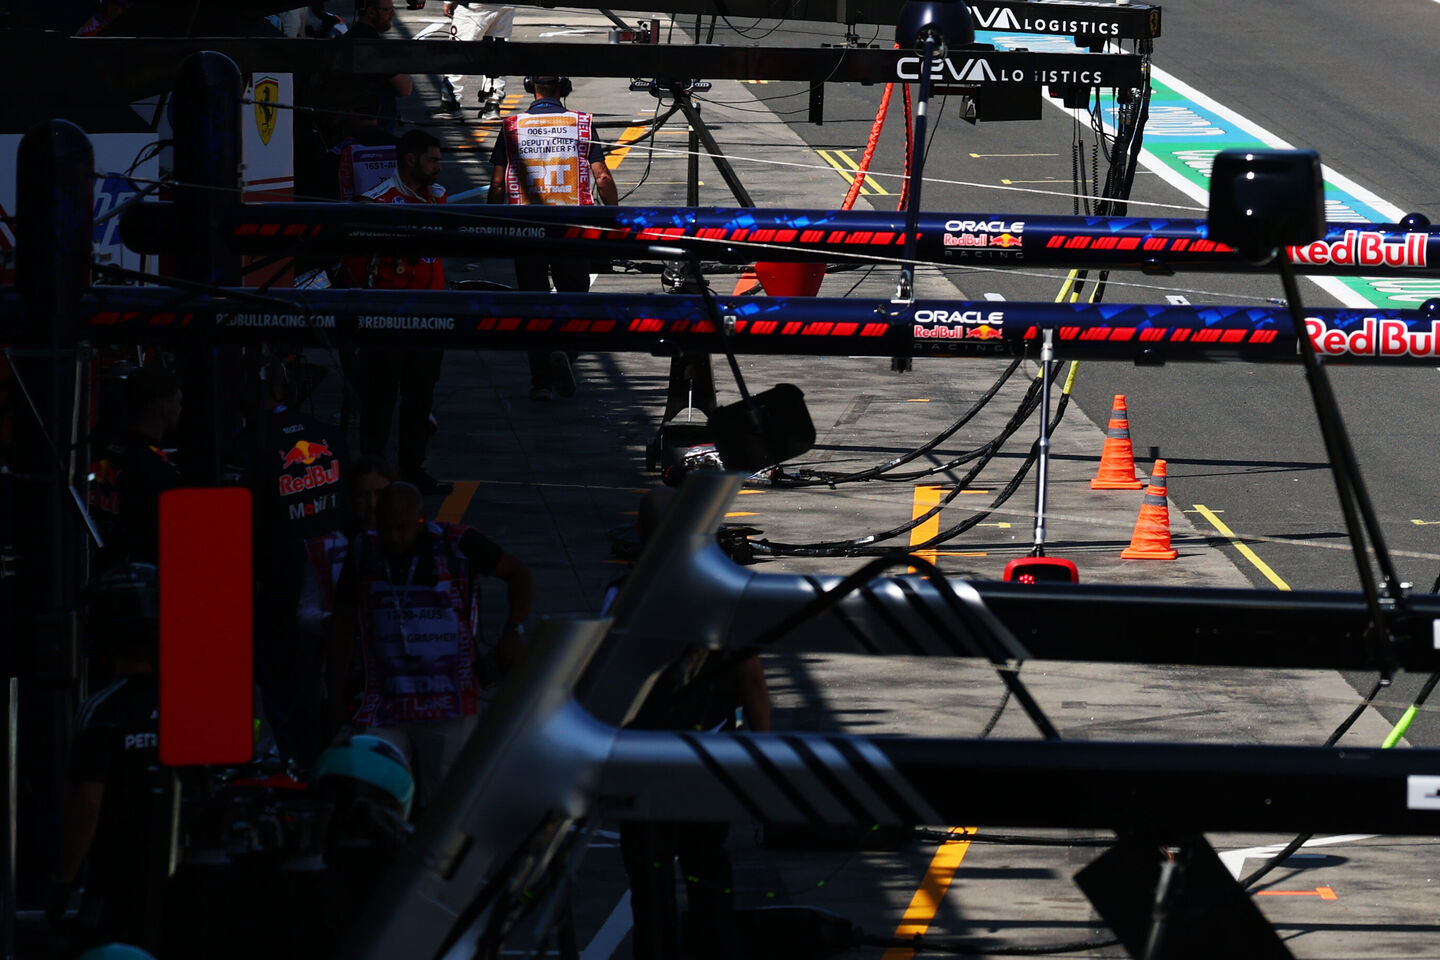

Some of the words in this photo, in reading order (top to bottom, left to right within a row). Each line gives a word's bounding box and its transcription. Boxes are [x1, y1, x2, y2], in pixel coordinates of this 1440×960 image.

[1024, 17, 1120, 36] LOGISTICS
[1000, 68, 1103, 83] LOISTICS
[527, 126, 568, 136] 0065-AUS
[521, 139, 550, 147] DEPUTY
[552, 138, 574, 146] CHIEF
[520, 145, 569, 155] SCRUTINEER
[944, 220, 1025, 233] ORACLE
[914, 310, 1004, 325] ORACLE
